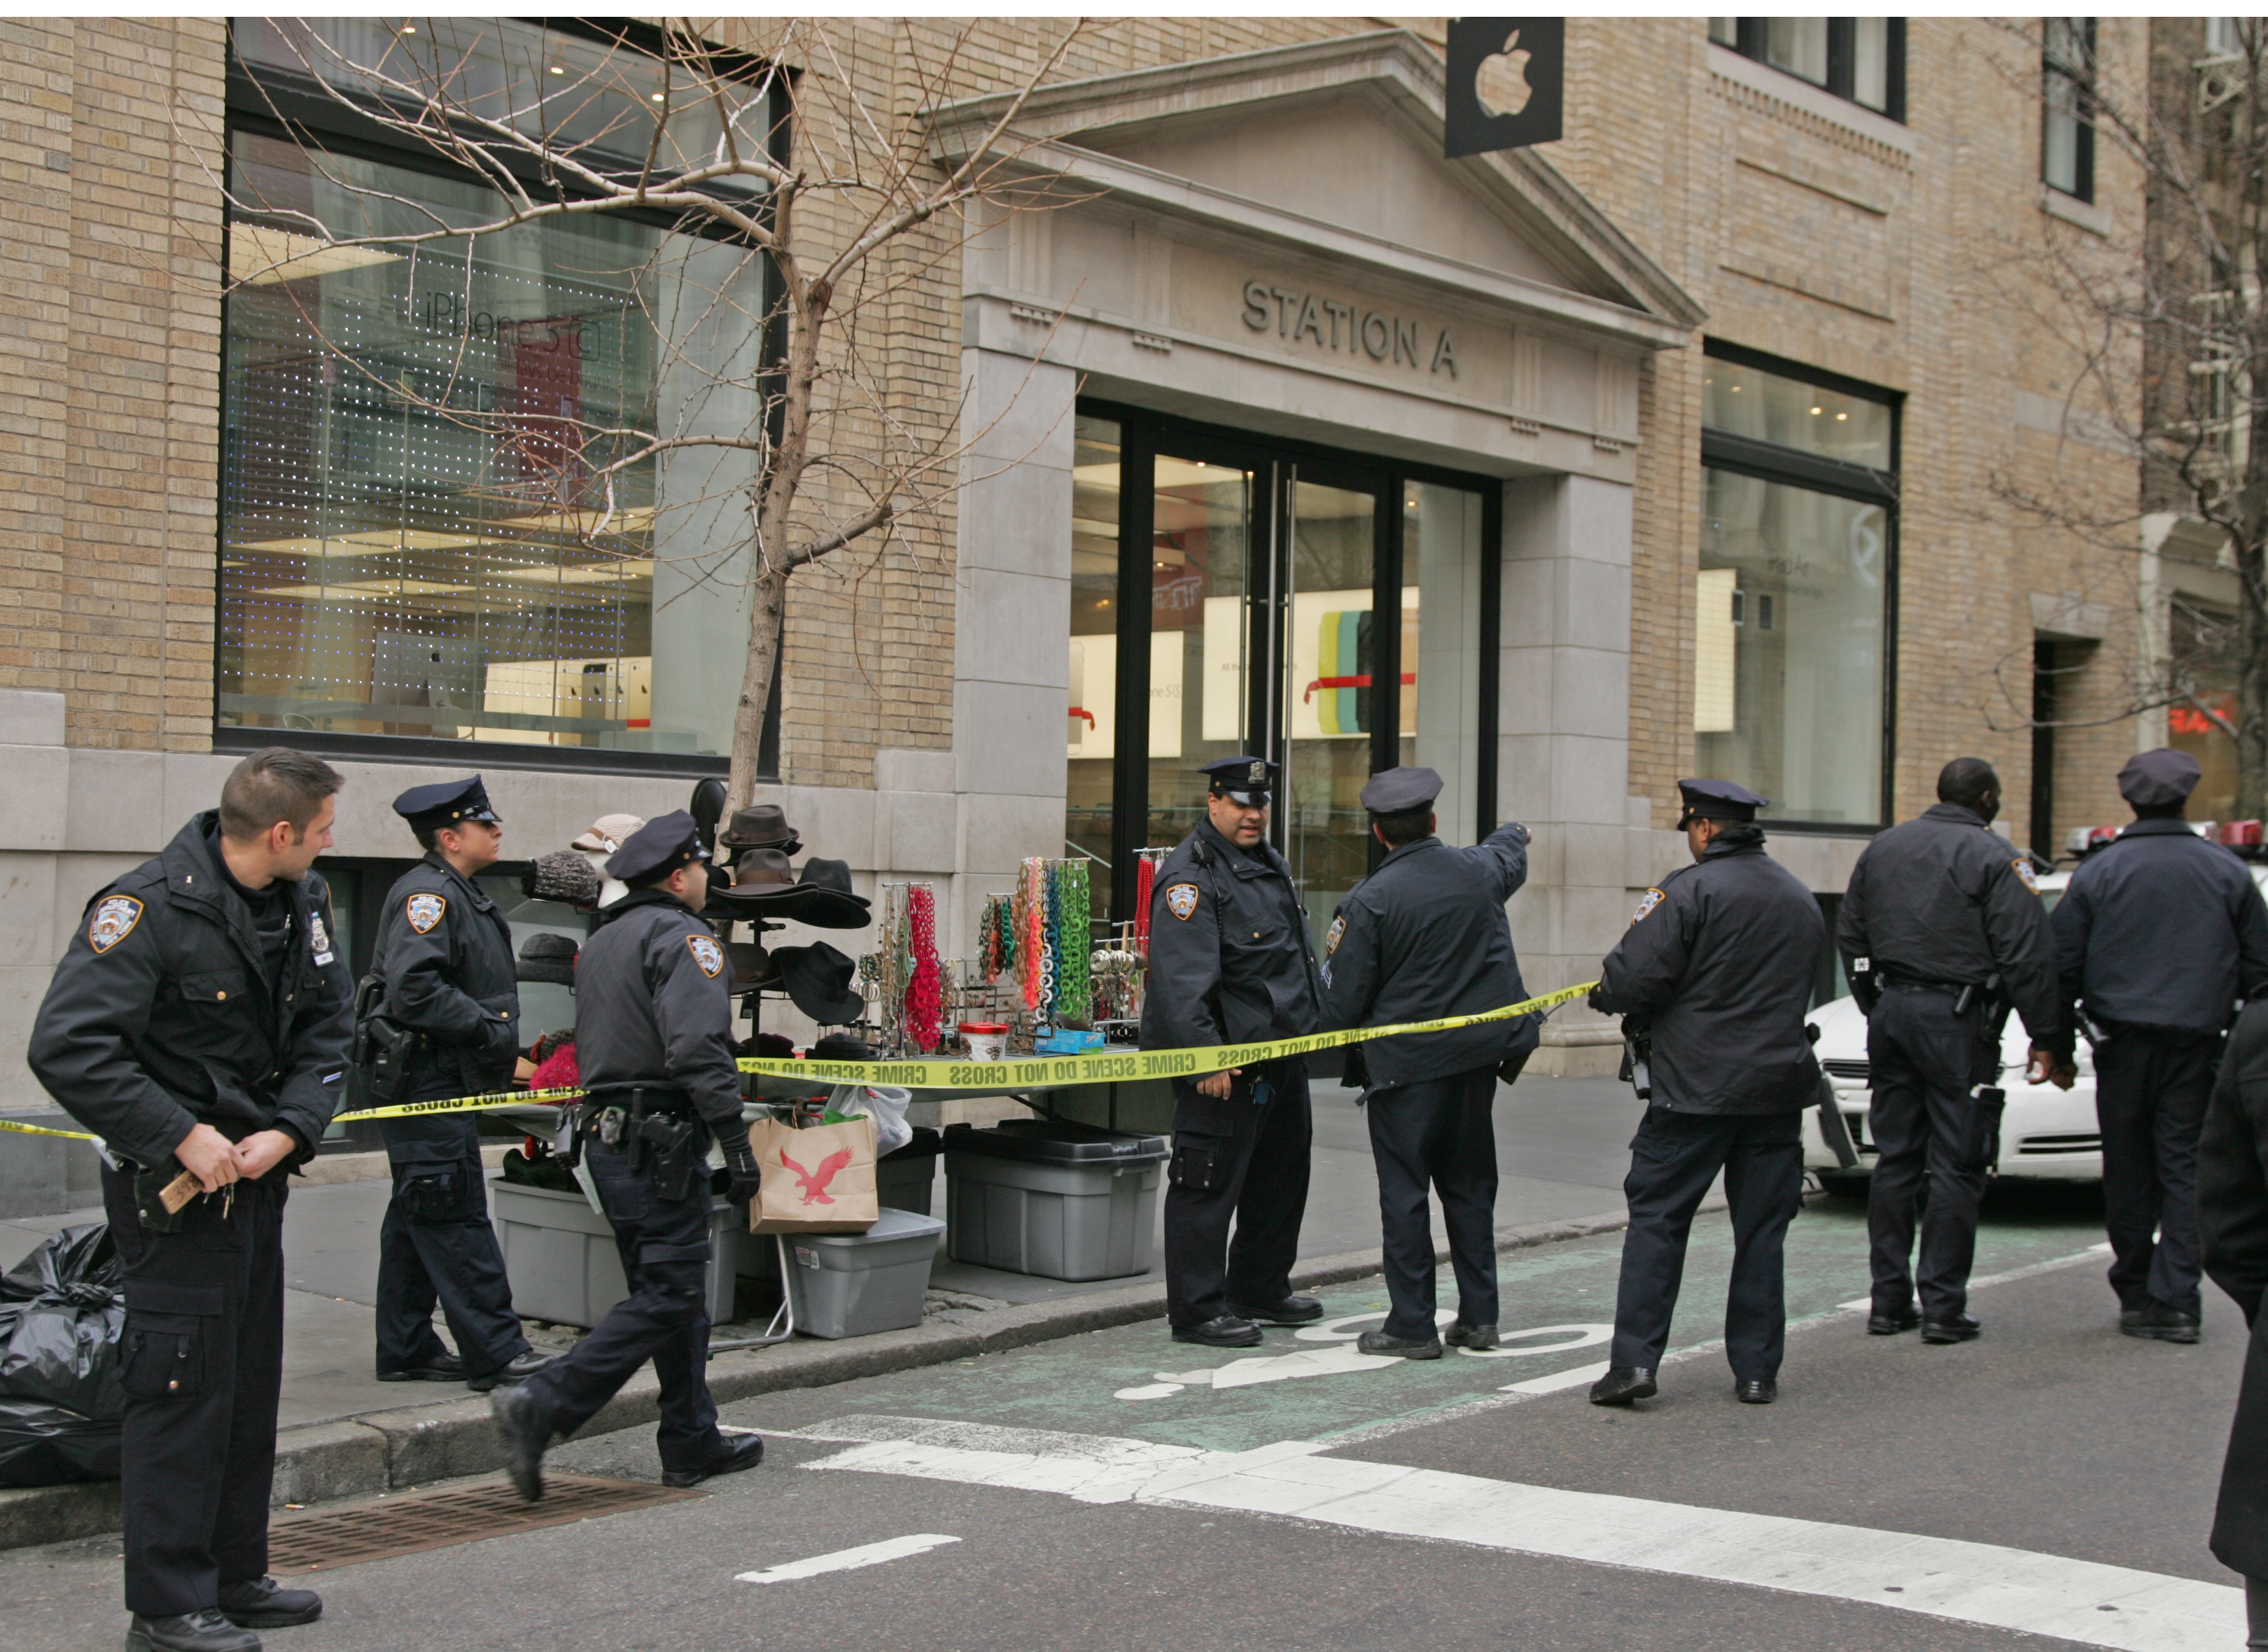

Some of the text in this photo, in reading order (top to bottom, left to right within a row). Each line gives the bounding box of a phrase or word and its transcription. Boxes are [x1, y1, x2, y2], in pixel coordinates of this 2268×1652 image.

[426, 291, 534, 348] iPhone
[1241, 281, 1459, 379] STATION A
[485, 355, 542, 382] holidays
[547, 364, 566, 382] be
[99, 904, 136, 916] DEPARTMENT
